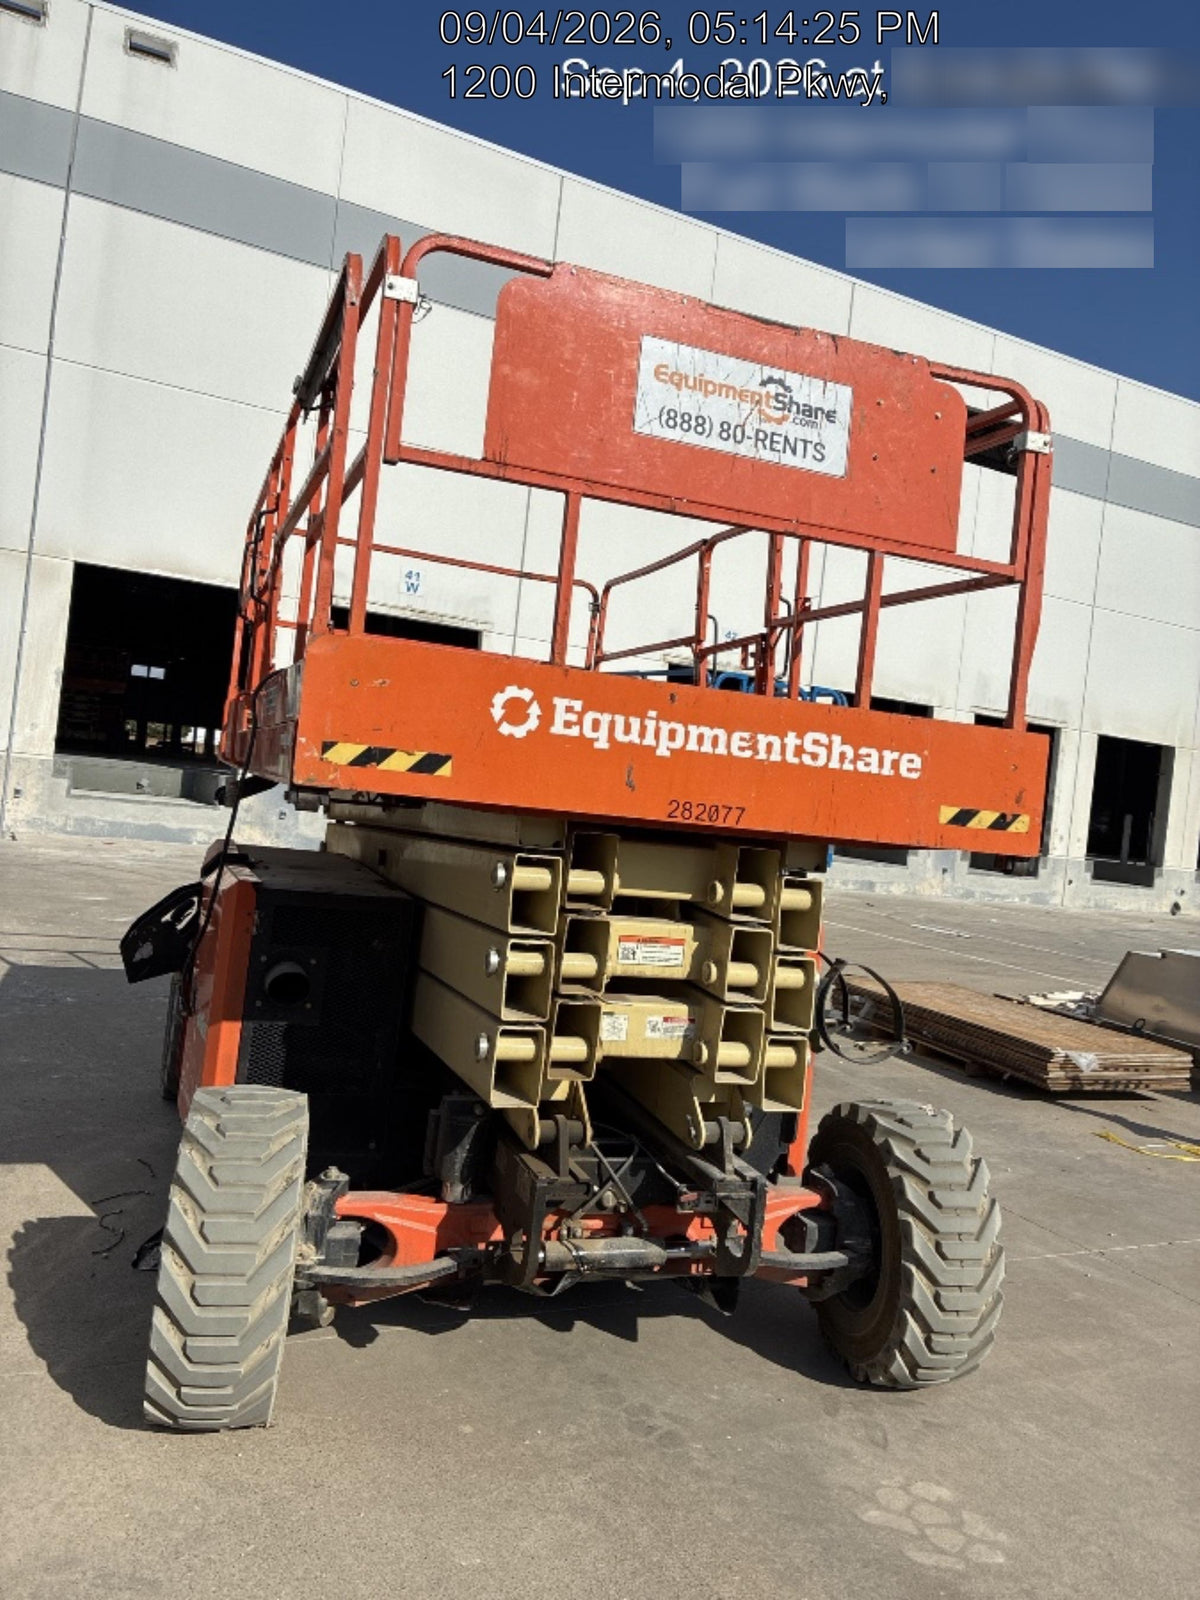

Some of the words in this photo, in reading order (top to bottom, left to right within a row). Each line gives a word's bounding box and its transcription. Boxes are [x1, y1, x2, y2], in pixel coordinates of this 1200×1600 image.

[654, 363, 837, 424] EquipmentShare
[658, 405, 713, 438] (888)
[719, 420, 826, 463] 80-RENTS
[404, 569, 420, 581] 41
[404, 580, 420, 594] W
[549, 696, 923, 780] EquipmentShare
[667, 799, 746, 826] 282077
